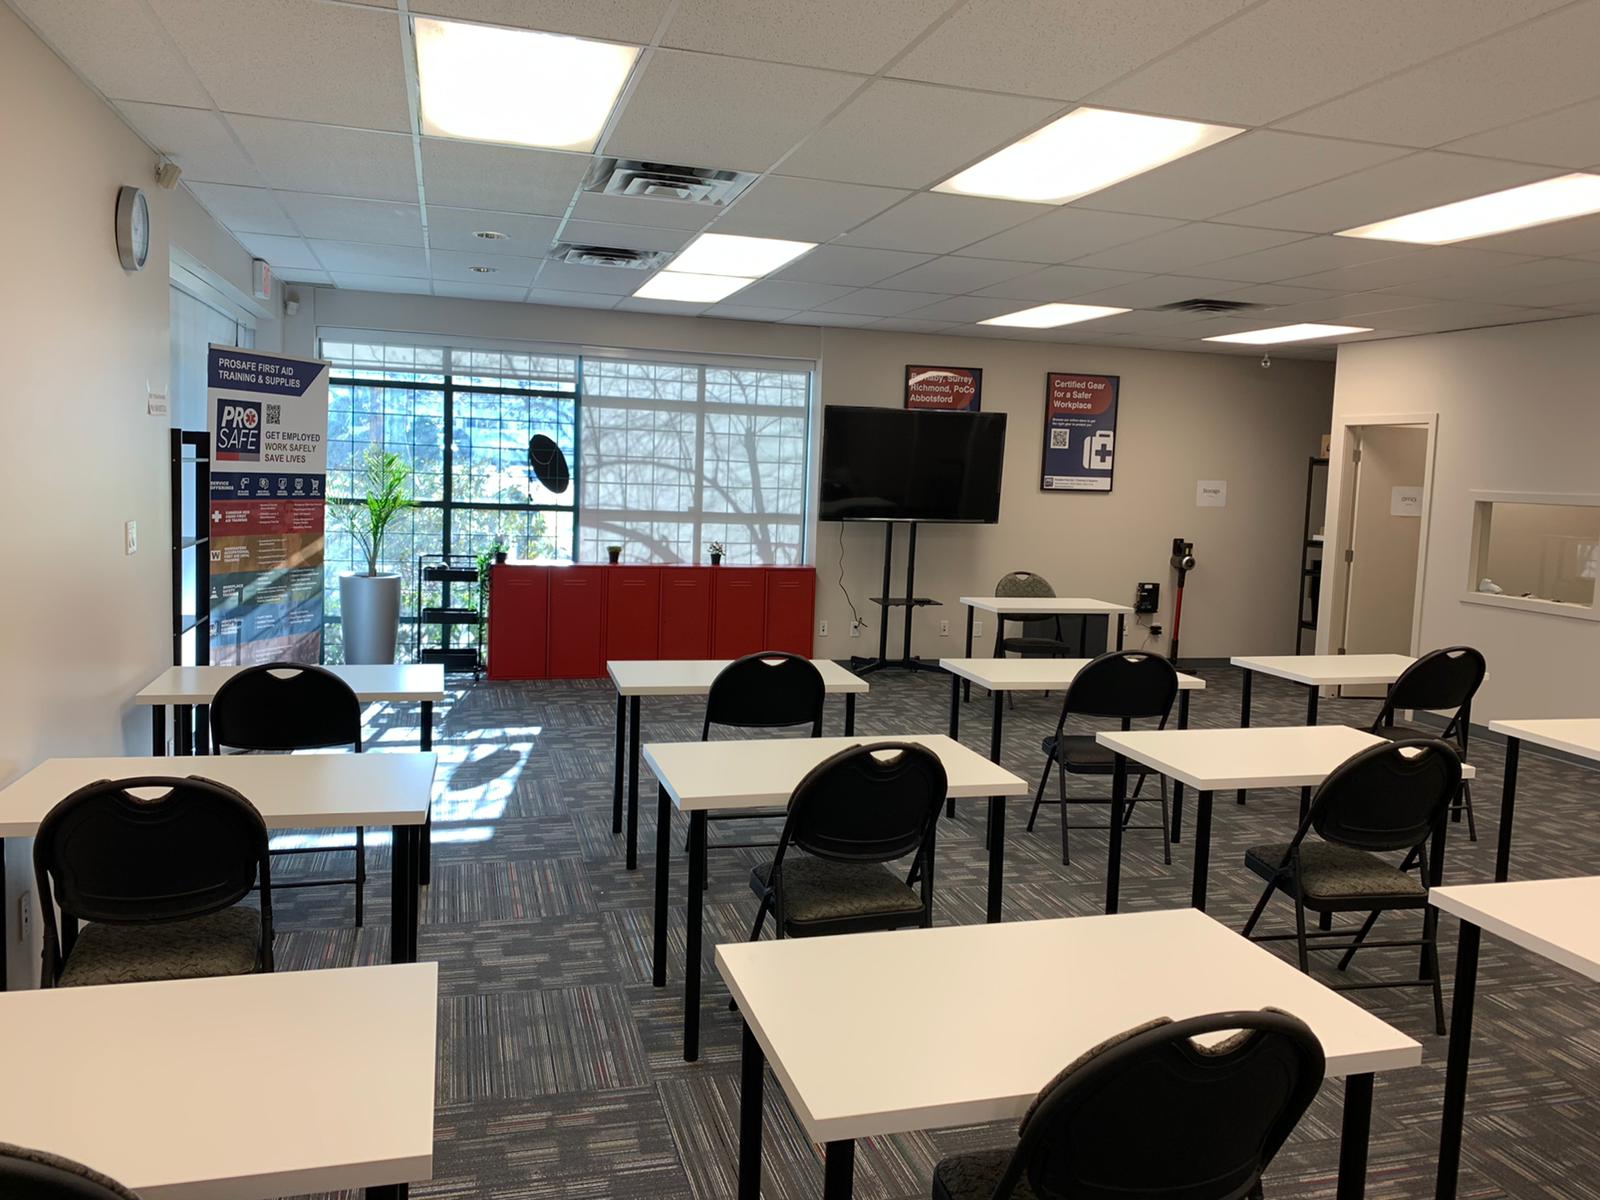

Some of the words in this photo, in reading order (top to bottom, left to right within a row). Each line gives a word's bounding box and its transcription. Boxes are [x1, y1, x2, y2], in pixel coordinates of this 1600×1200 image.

[218, 358, 257, 371] PROSAFE
[258, 363, 280, 374] FIRST
[281, 366, 294, 376] AID
[218, 370, 256, 383] TRAINING
[257, 375, 264, 384] &
[265, 376, 301, 388] SUPPLIES
[910, 384, 952, 393] Richmond,
[953, 385, 975, 393] PoCo
[1054, 380, 1086, 389] Certified
[1087, 381, 1106, 390] Gear
[910, 394, 953, 403] Abbotsford
[1054, 390, 1064, 398] for
[1072, 390, 1092, 399] Safer
[1053, 400, 1092, 410] Workplace
[221, 406, 259, 429] PRO
[218, 428, 258, 450] SAFE
[265, 431, 280, 440] GET
[282, 432, 321, 442] EMPLOYED
[265, 443, 288, 451] WORK
[289, 444, 317, 453] SAFELY
[265, 453, 284, 463] SAVE
[286, 455, 306, 463] LIVES
[211, 551, 220, 560] W
